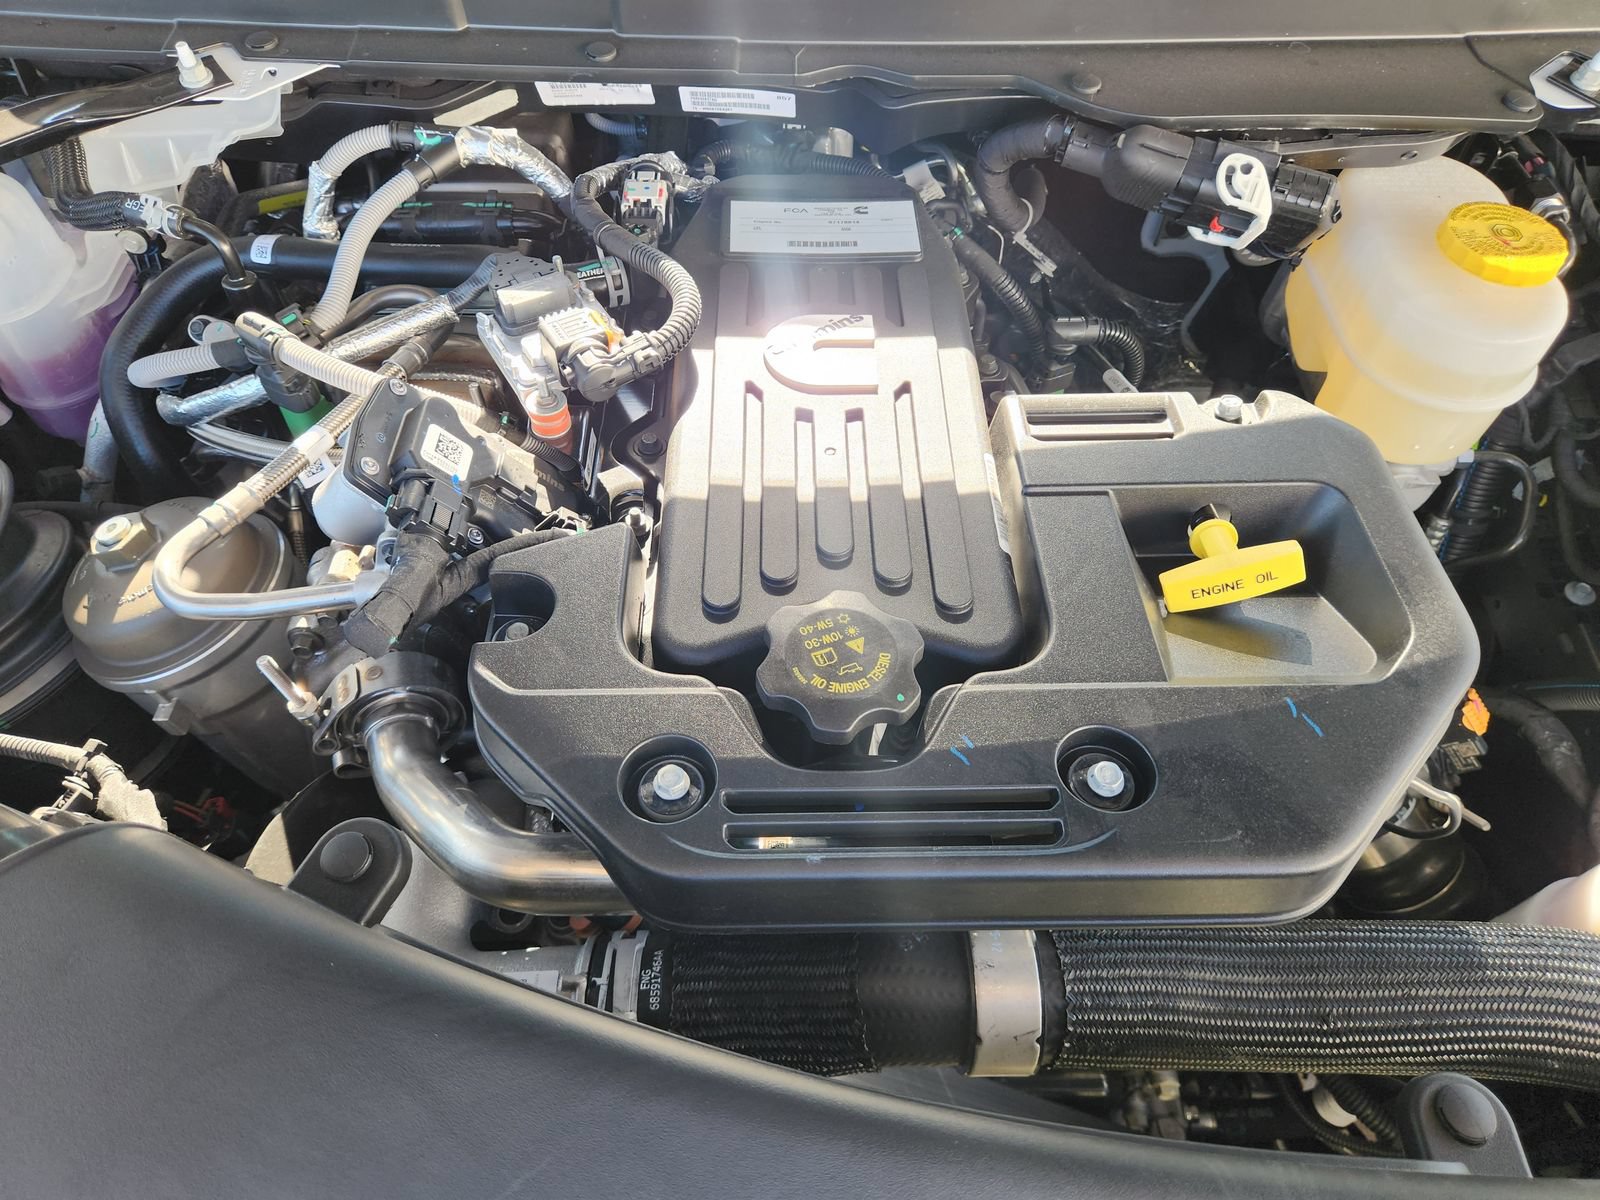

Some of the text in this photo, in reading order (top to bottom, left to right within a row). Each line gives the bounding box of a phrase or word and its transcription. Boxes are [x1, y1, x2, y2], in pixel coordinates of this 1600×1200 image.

[1191, 571, 1279, 599] ENGINE OIL
[799, 618, 834, 636] 5W-40
[804, 631, 844, 650] 10W-30
[867, 652, 891, 682] DIESEL
[810, 673, 828, 690] OIL
[827, 678, 871, 694] ENGINE
[640, 968, 652, 990] ENG
